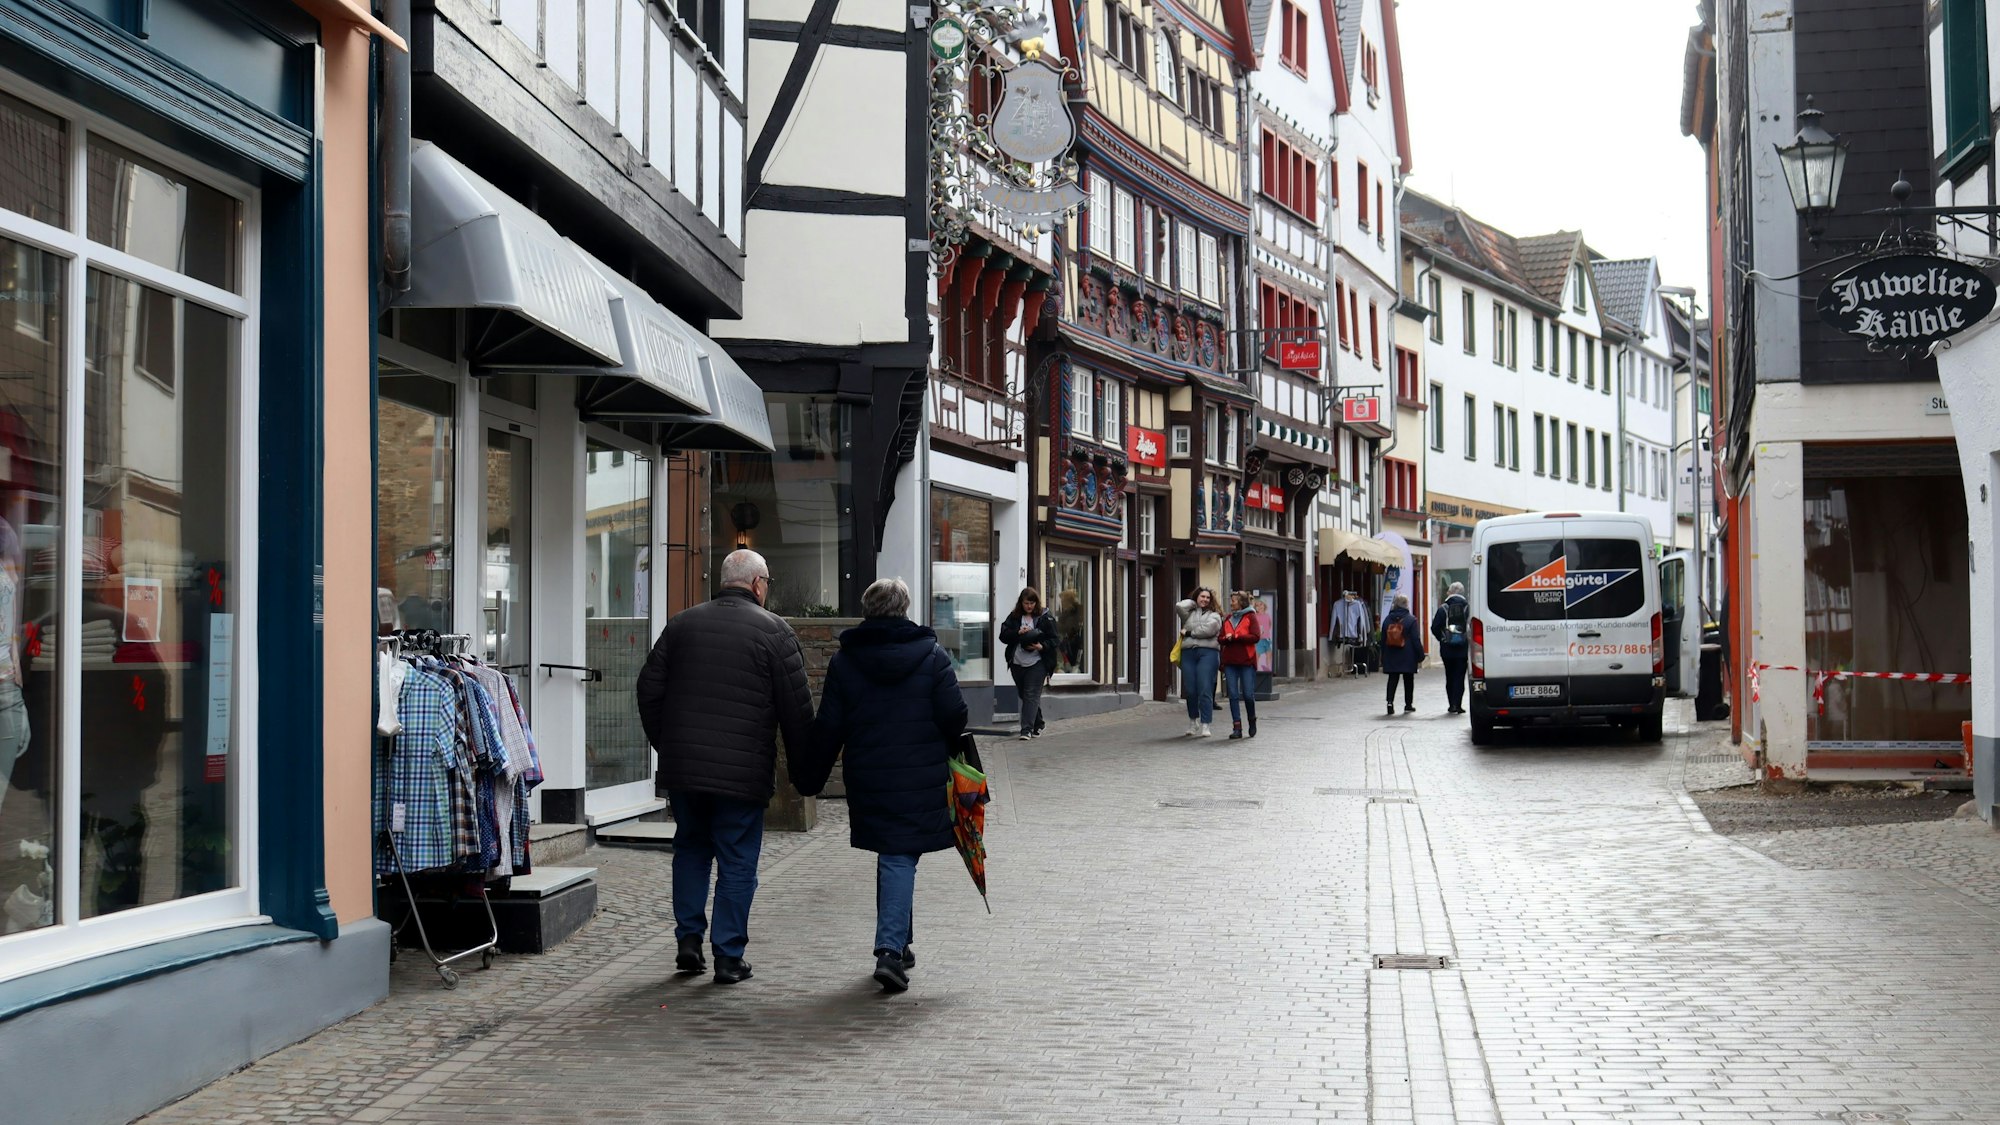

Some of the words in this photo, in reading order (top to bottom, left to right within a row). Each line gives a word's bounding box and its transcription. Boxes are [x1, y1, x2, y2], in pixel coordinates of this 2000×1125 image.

[995, 191, 1070, 209] HOTEL
[1831, 267, 1981, 315] Juwelier
[1849, 304, 1966, 339] Kälble
[1531, 573, 1608, 589] Hochgürtel
[1486, 625, 1521, 633] Beratung
[1524, 623, 1556, 631] Planung
[1560, 622, 1593, 630] Montage
[1598, 621, 1649, 629] Kundendienst
[1537, 685, 1559, 695] 8864
